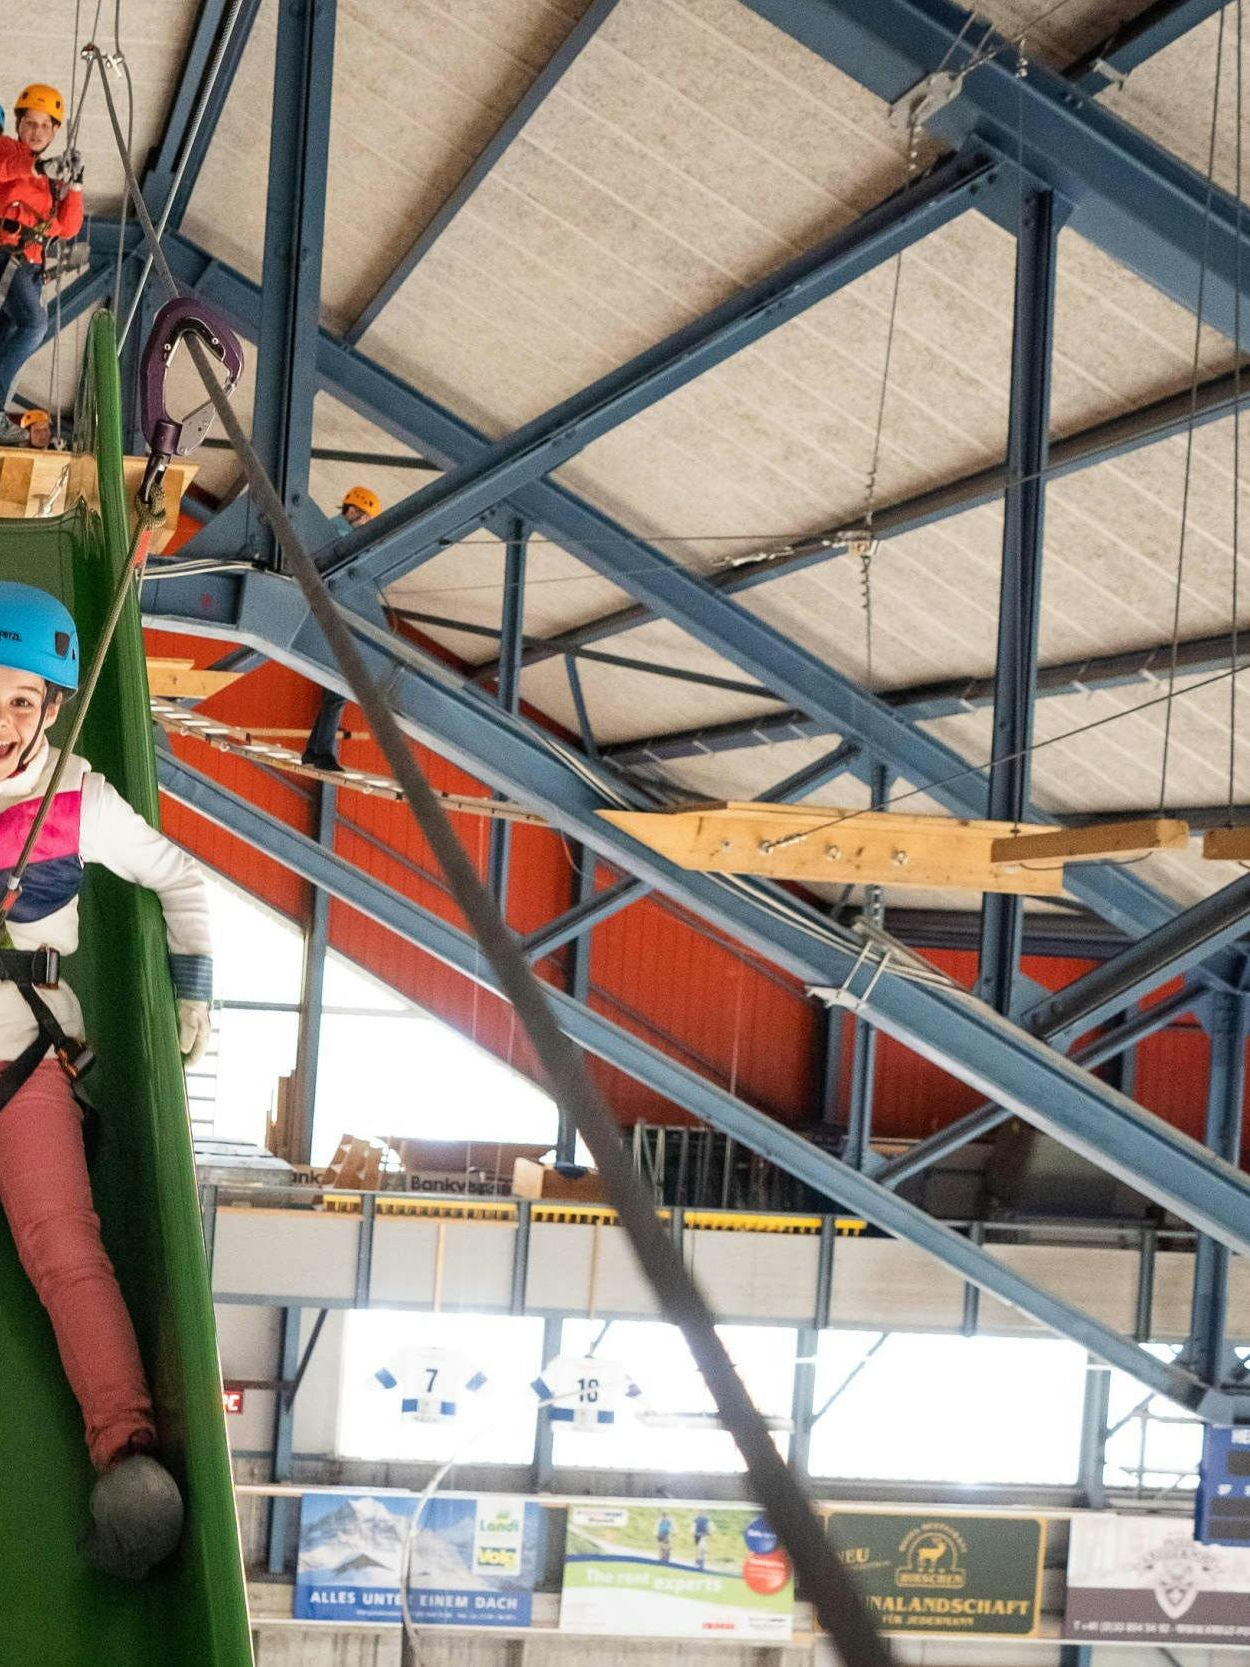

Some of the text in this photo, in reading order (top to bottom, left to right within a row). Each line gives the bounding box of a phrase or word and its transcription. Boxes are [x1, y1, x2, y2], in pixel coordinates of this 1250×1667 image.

[425, 1368, 438, 1393] 7
[310, 1591, 356, 1605] ALLES
[419, 1594, 469, 1609] EINEM
[474, 1596, 518, 1611] DACH
[867, 1595, 1030, 1616] NALANDSCHAFT
